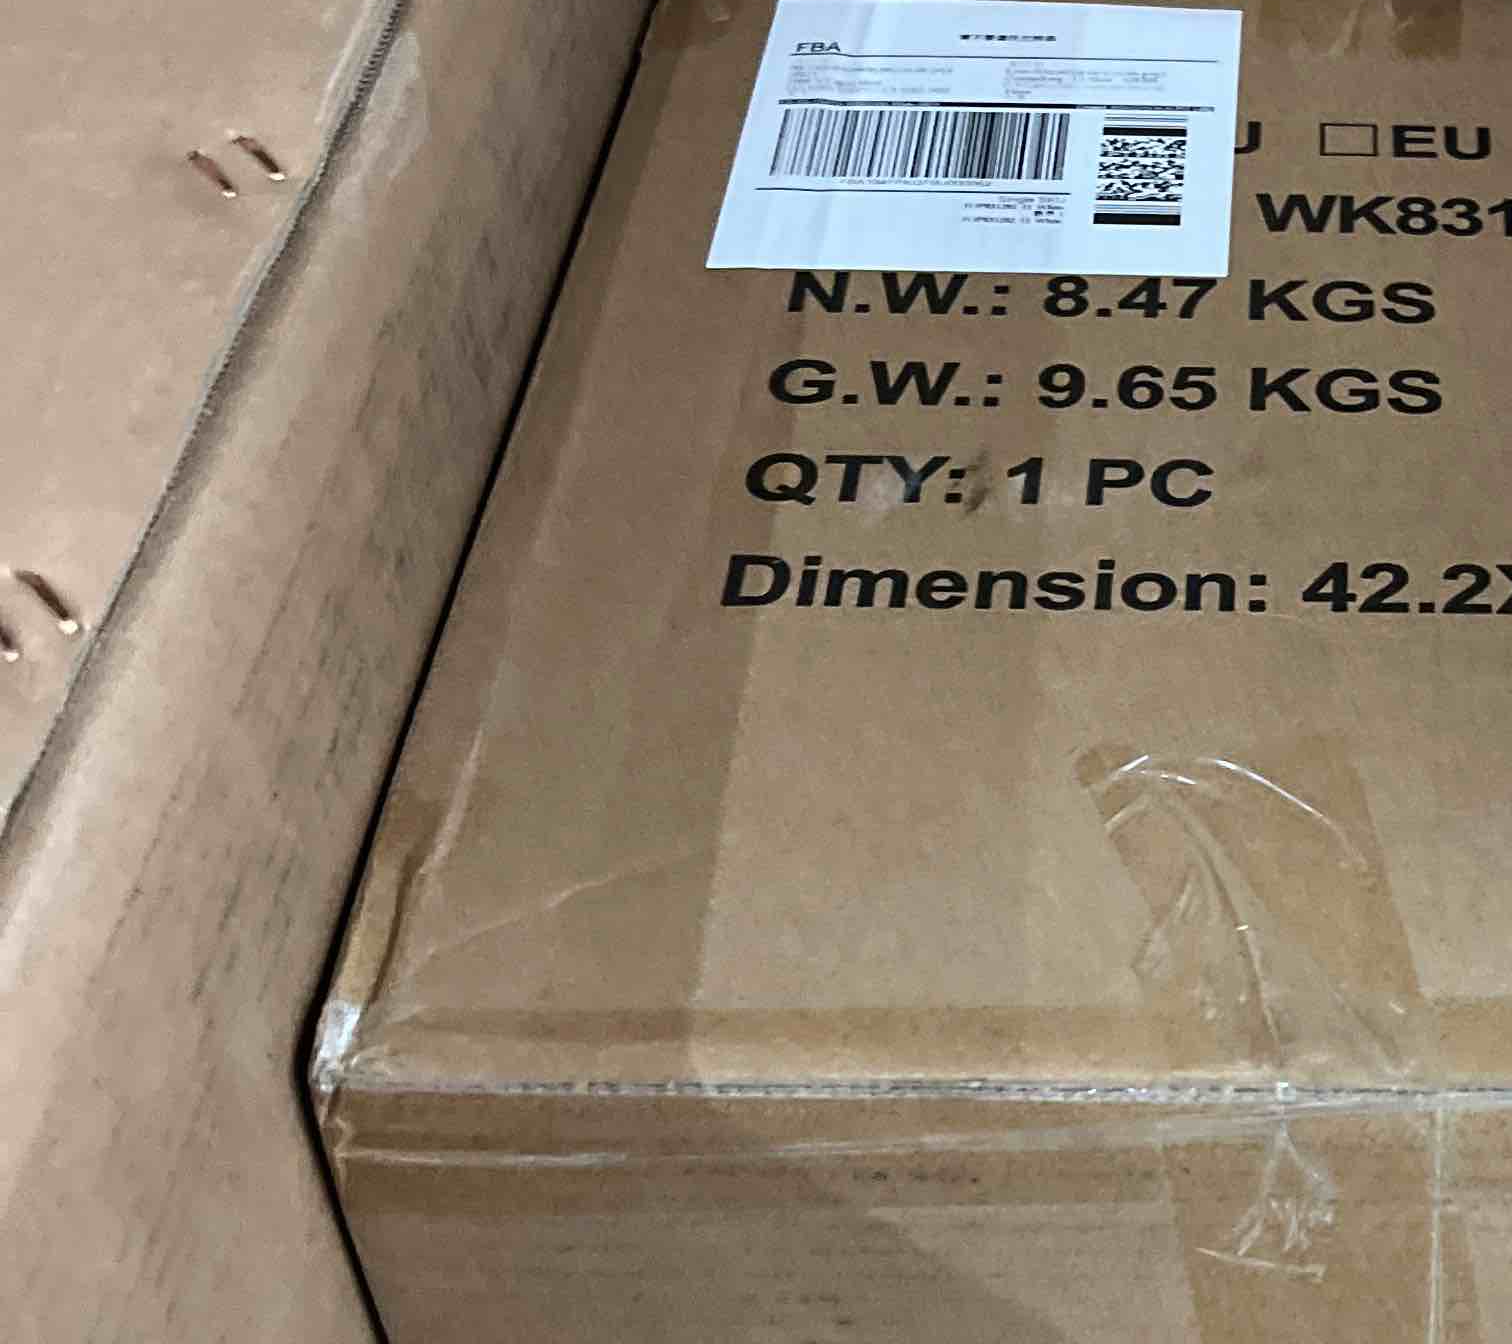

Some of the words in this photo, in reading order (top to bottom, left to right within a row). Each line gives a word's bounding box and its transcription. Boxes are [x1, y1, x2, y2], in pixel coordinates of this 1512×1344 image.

[796, 41, 842, 53] FBA
[1392, 124, 1492, 160] EU
[786, 270, 1011, 317] N.W.:
[1041, 275, 1219, 320] 8.47
[1247, 278, 1438, 325] KGS
[767, 358, 1003, 408] G.W.:
[1037, 362, 1218, 411] 9.65
[1248, 366, 1444, 415] KGS
[744, 452, 965, 506] QTY:
[1006, 456, 1046, 506] 1
[1084, 457, 1215, 509] PC
[719, 553, 1269, 613] Dimension:
